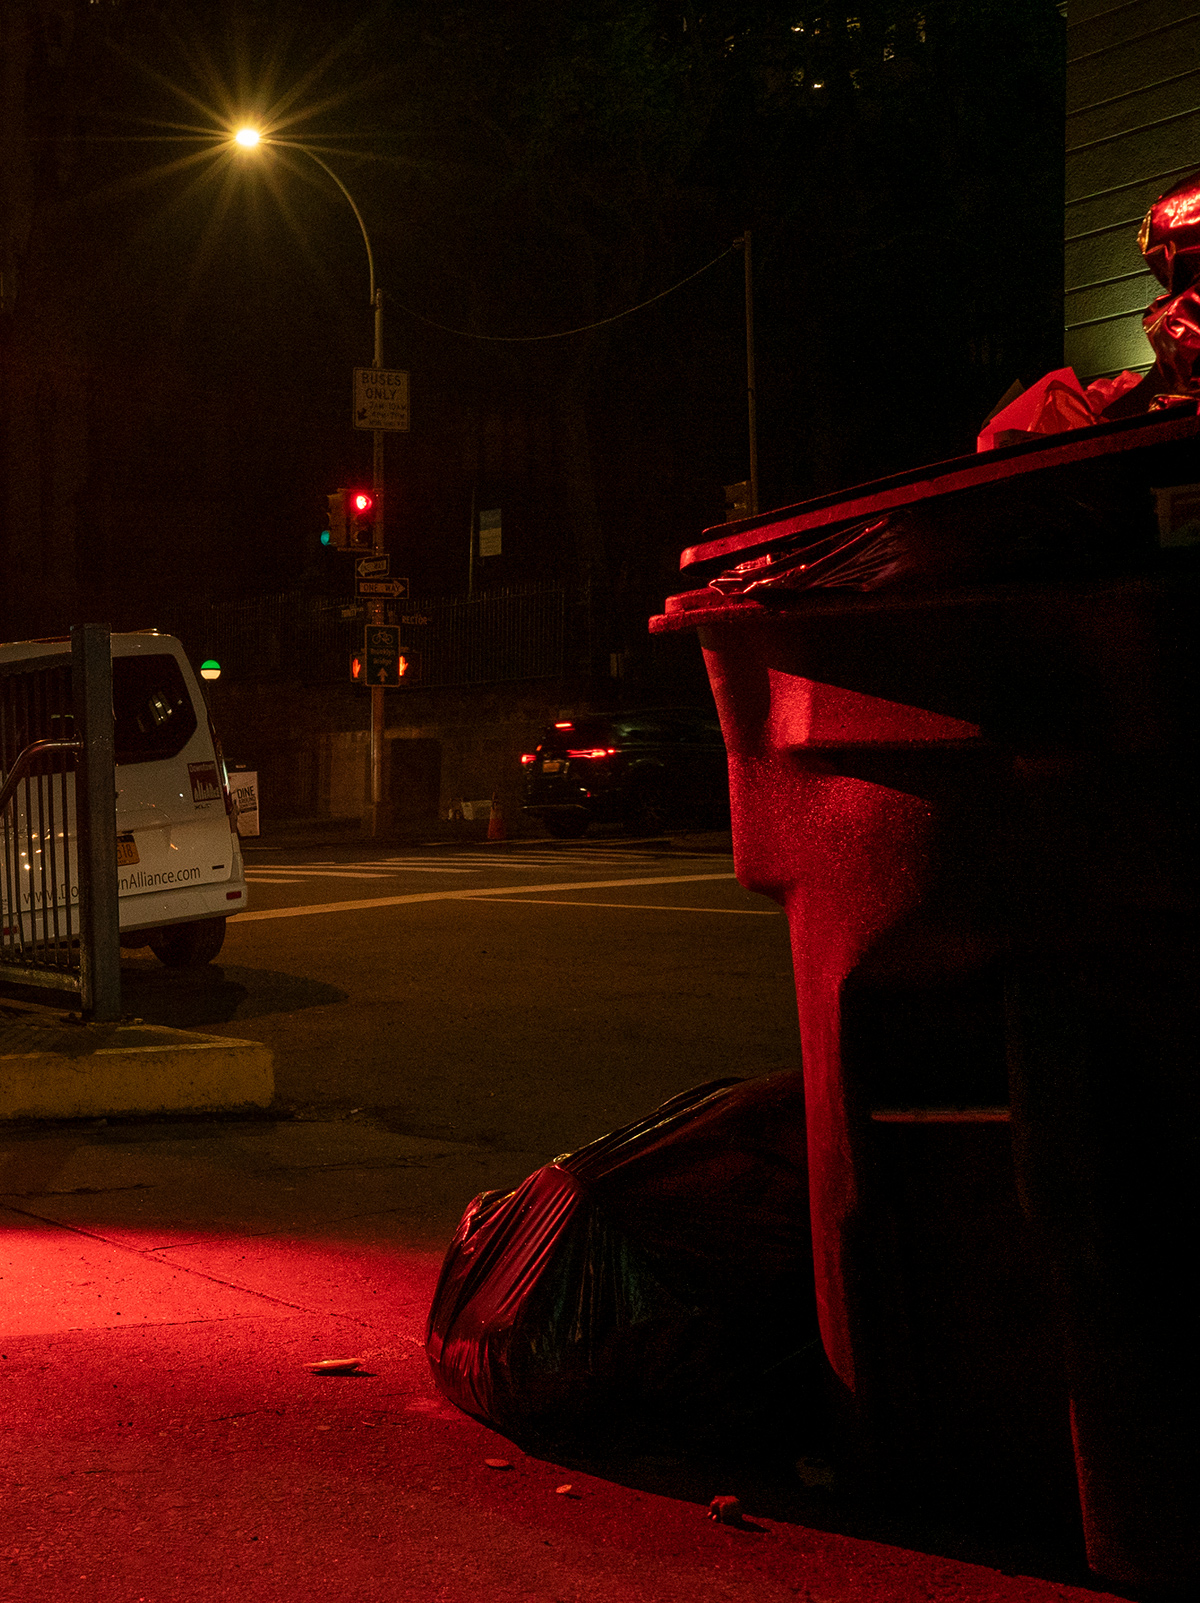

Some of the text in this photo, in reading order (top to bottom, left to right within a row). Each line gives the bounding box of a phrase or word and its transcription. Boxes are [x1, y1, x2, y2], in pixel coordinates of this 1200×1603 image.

[362, 373, 402, 387] BUSES
[365, 387, 397, 400] ONLY
[237, 785, 256, 798] DINE
